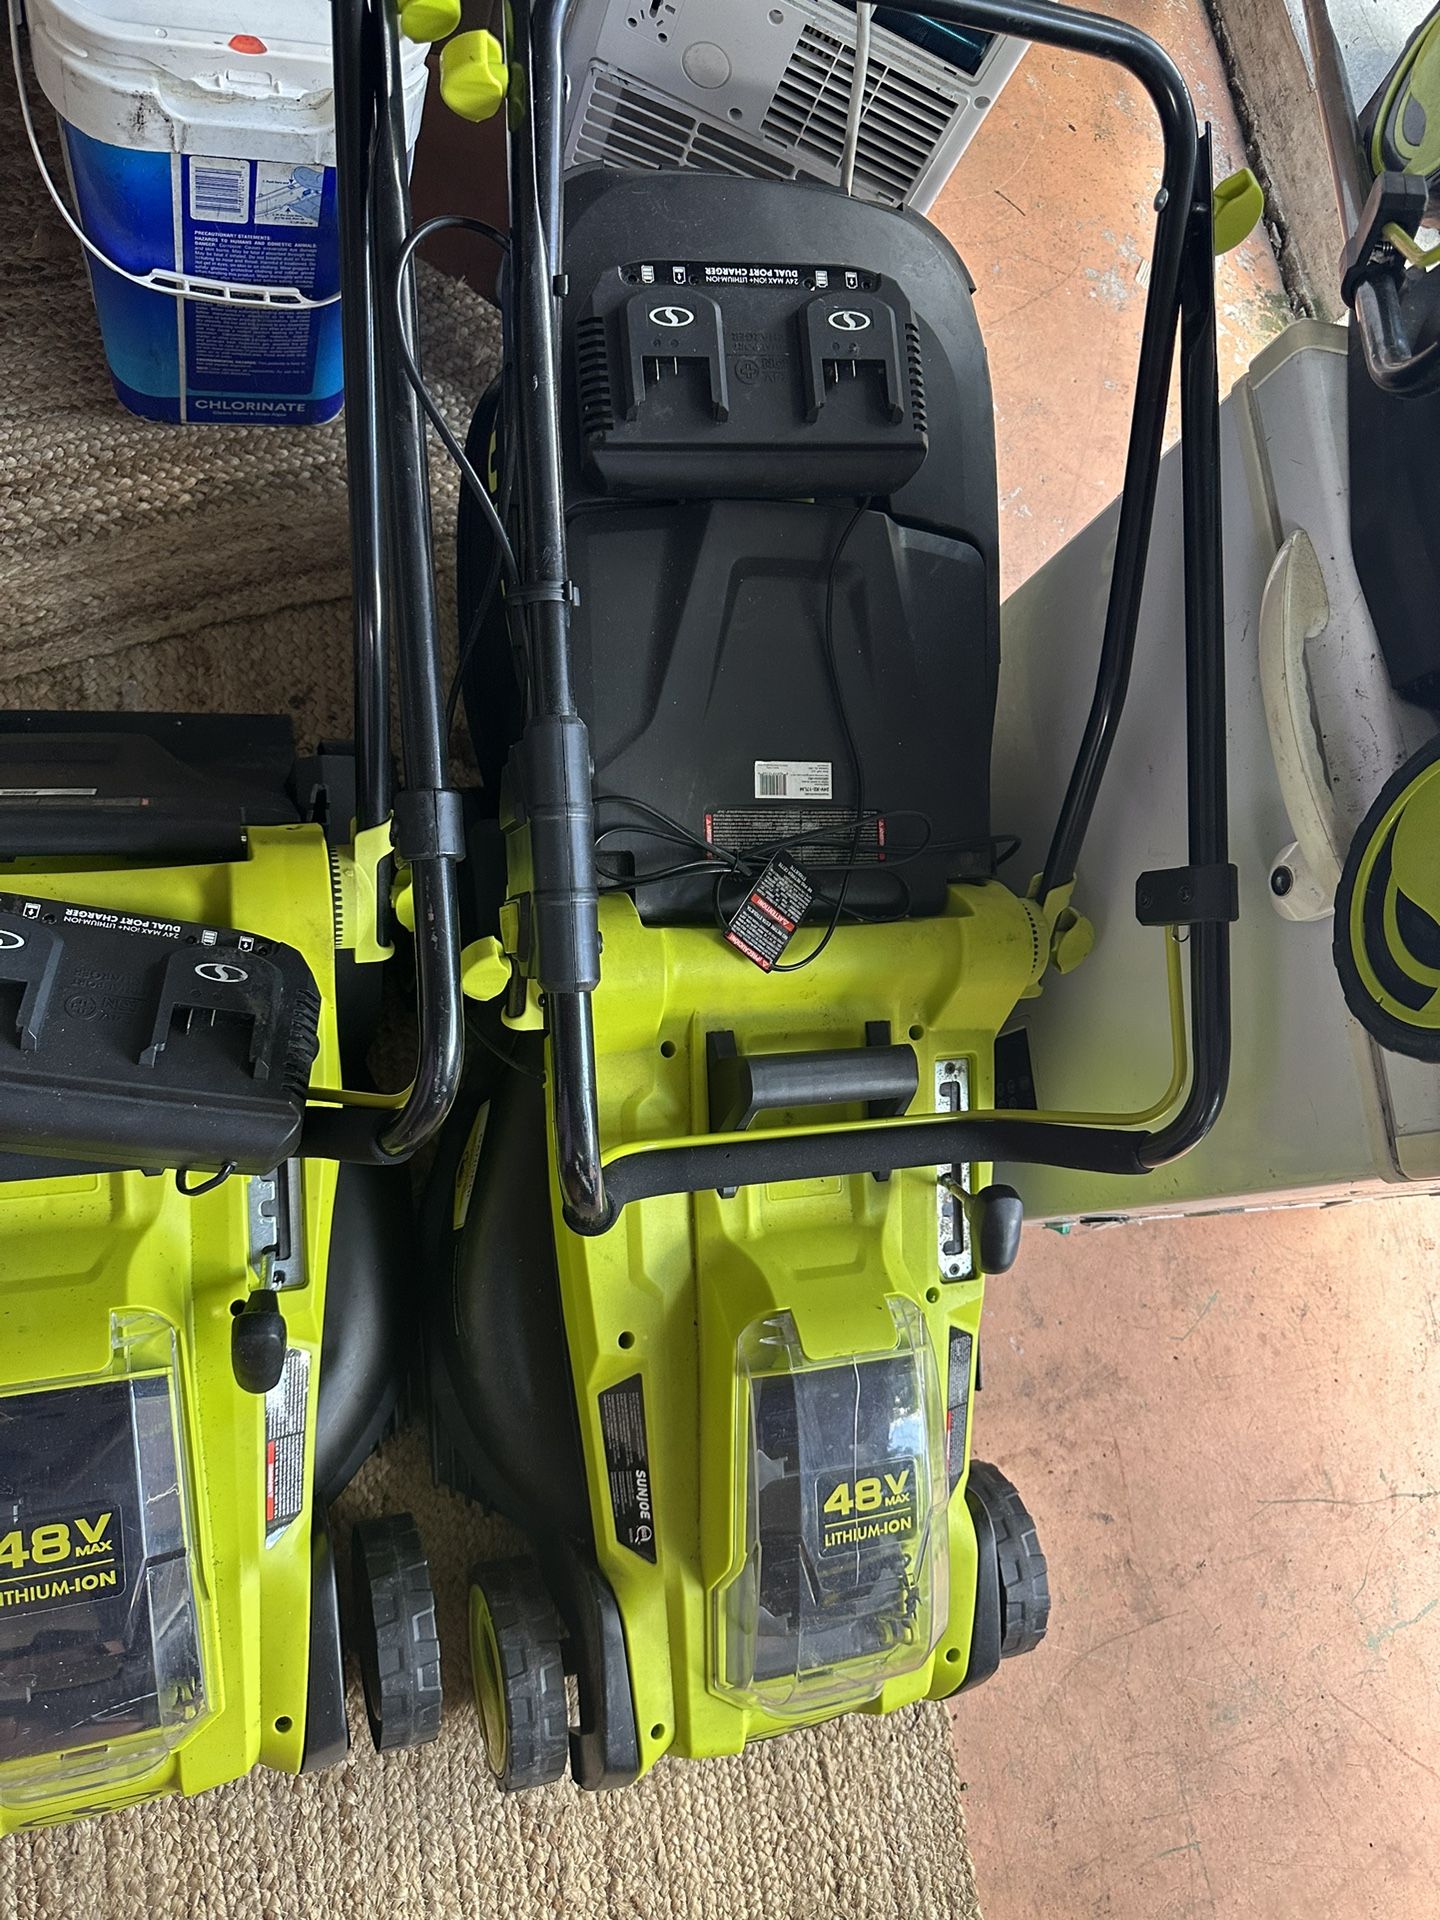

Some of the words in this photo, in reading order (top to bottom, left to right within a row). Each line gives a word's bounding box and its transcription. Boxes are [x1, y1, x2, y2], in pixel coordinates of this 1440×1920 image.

[705, 267, 747, 276] CHARGER
[749, 268, 773, 276] PORT
[774, 269, 798, 277] DUAL
[705, 275, 748, 284] LITHIUM-ION
[769, 277, 783, 285] MAX
[195, 399, 306, 412] CHLORINATE
[65, 908, 119, 923] CHARGER
[63, 915, 117, 929] LITHIUM-ION
[120, 917, 150, 928] PORT
[151, 921, 181, 933] DUAL
[141, 927, 161, 937] MAX
[163, 931, 180, 939] 24V
[885, 1493, 910, 1507] MAX
[825, 1516, 912, 1547] LITHIUM-ION
[75, 1540, 113, 1557] MAX
[0, 1570, 117, 1607] ITHIUM-ION
